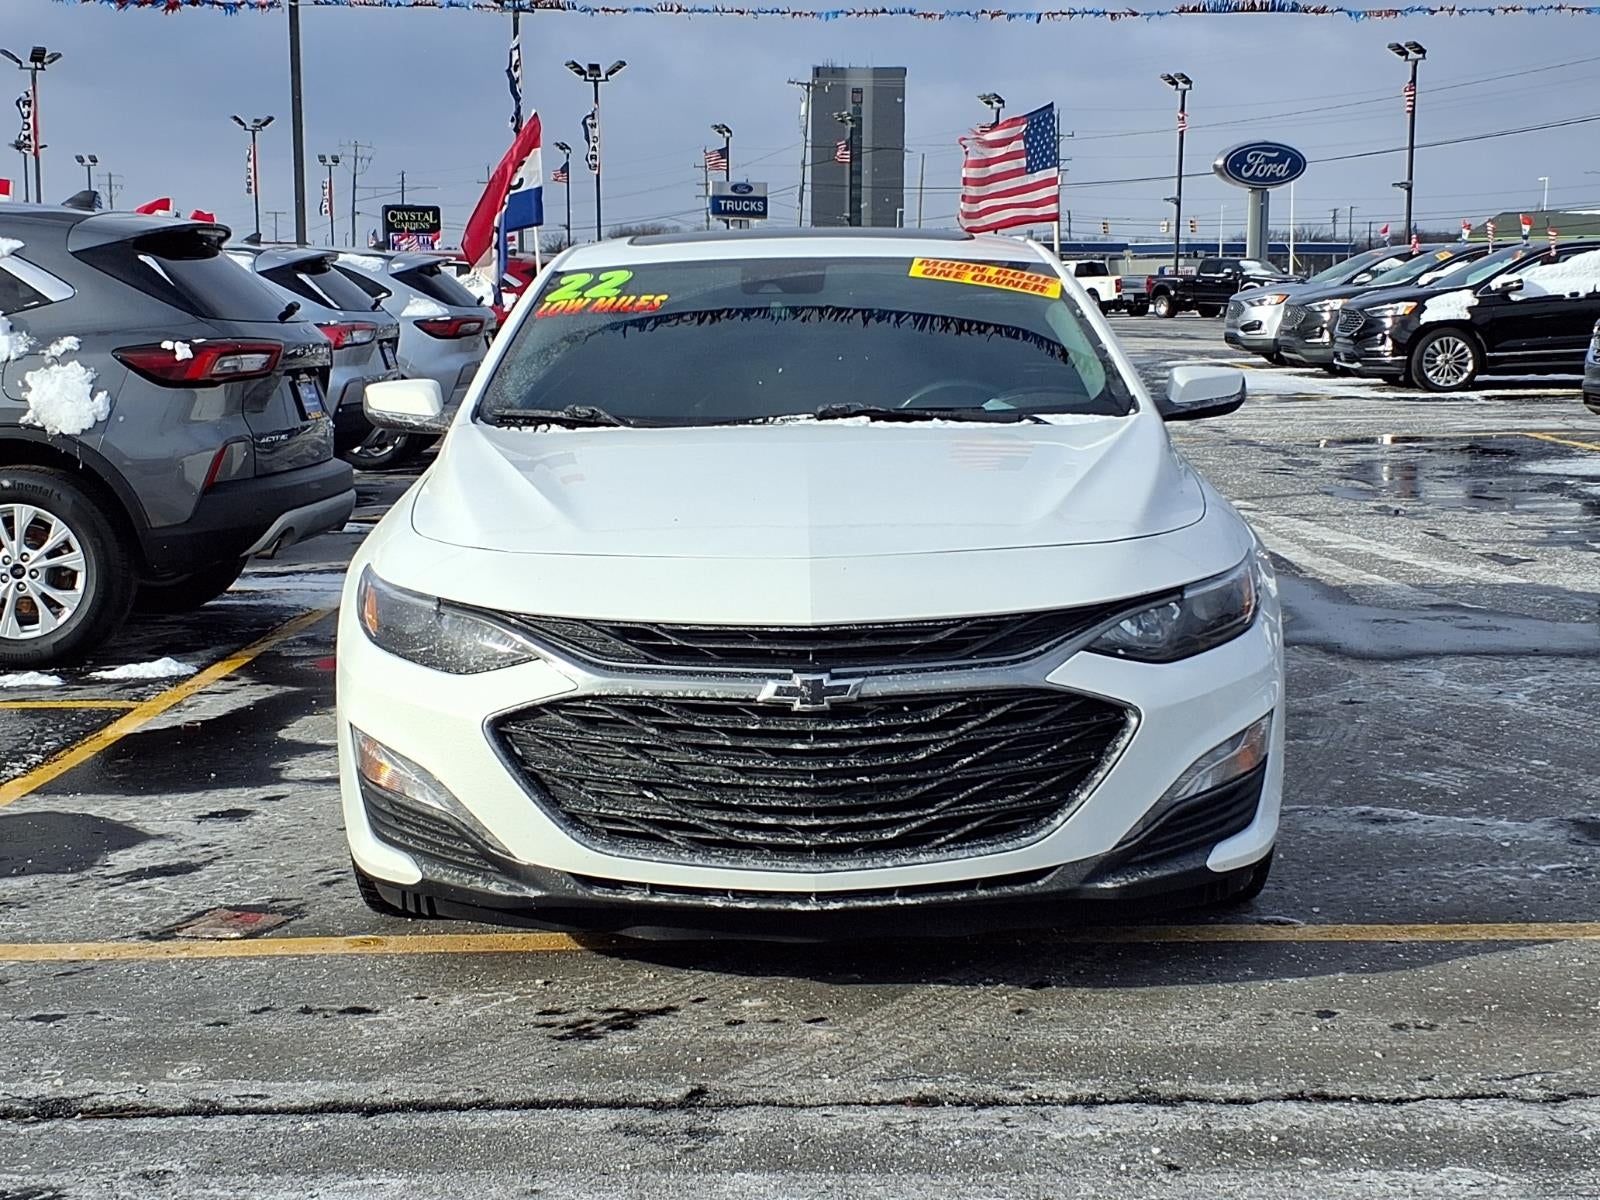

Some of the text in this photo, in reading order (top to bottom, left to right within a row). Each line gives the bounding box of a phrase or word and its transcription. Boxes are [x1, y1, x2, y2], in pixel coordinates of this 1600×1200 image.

[1241, 150, 1292, 178] Ford
[387, 210, 438, 223] CRYSTAL
[719, 200, 764, 212] TRUCKS
[394, 222, 430, 230] GARDENS
[918, 259, 1055, 286] MOON ROOF
[922, 267, 1049, 295] ONE OWNER
[545, 269, 634, 302] 22
[535, 294, 669, 317] LOW MILES
